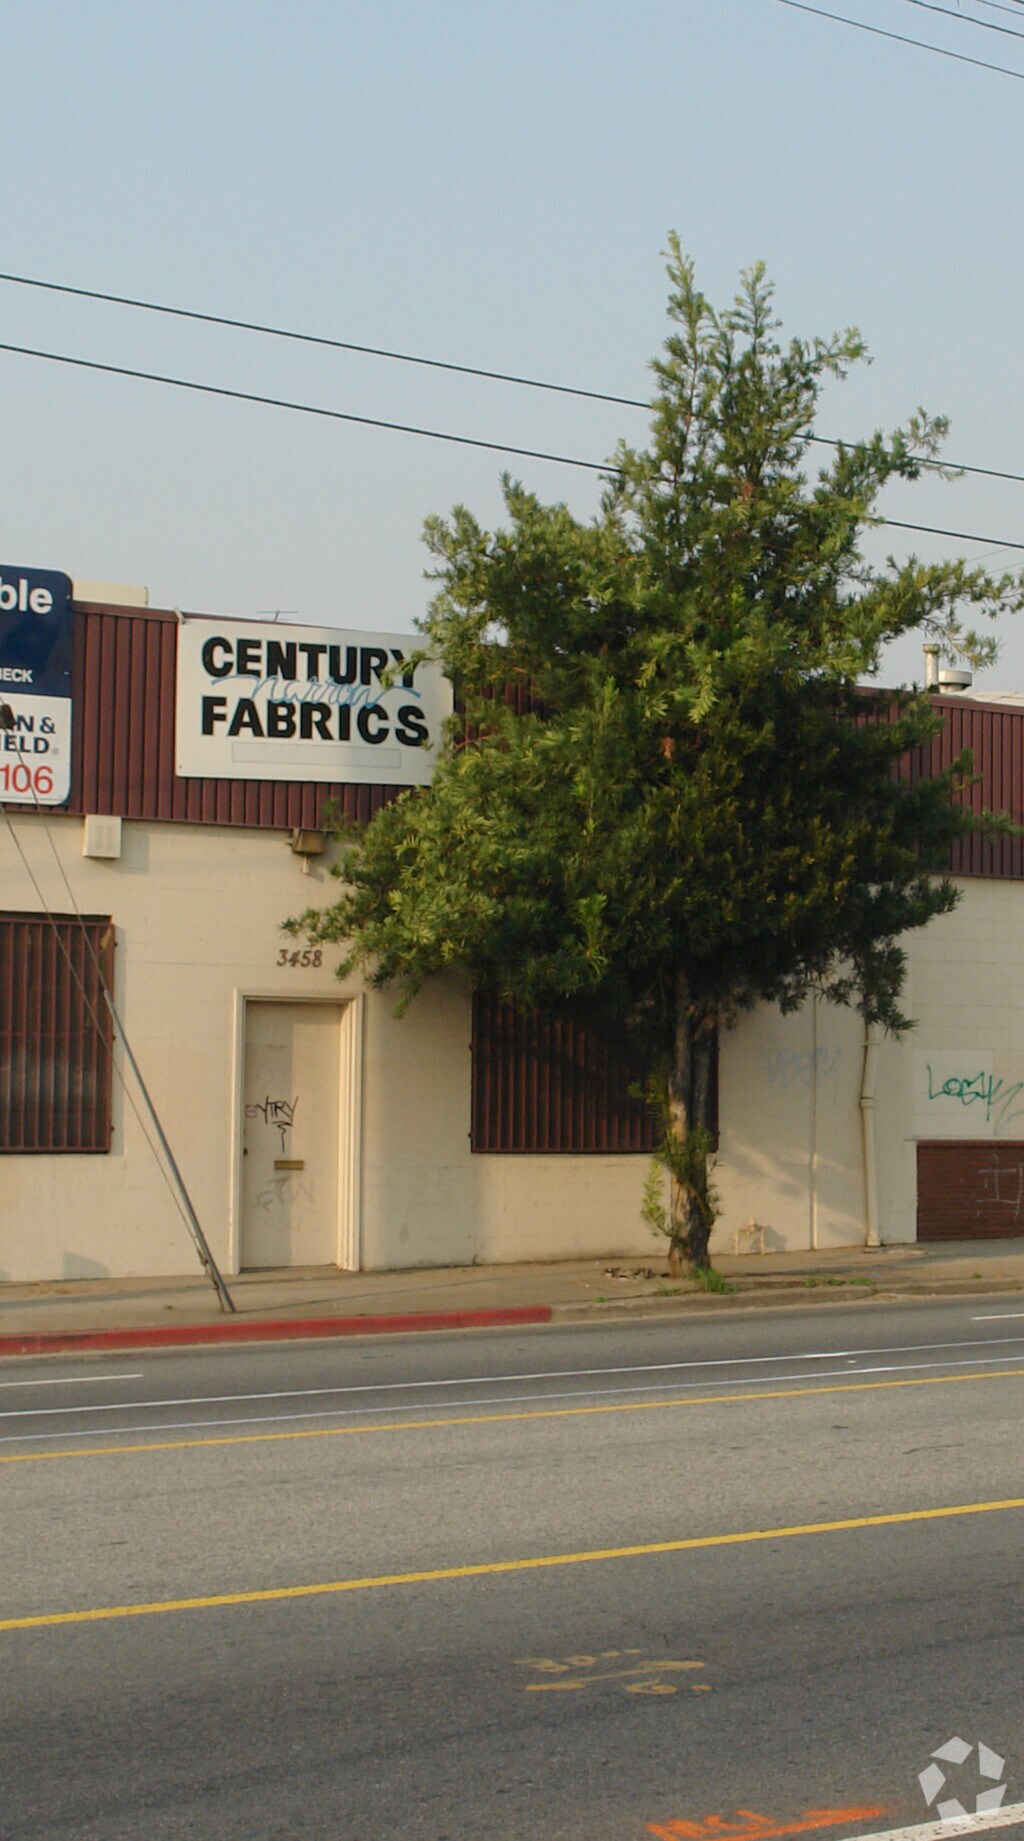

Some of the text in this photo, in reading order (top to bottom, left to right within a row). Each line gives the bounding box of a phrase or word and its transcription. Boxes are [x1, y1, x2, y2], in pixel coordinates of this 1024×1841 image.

[201, 636, 420, 688] CENTURY
[39, 716, 57, 734] &
[201, 695, 430, 746] FABRICS
[277, 949, 323, 968] 3458
